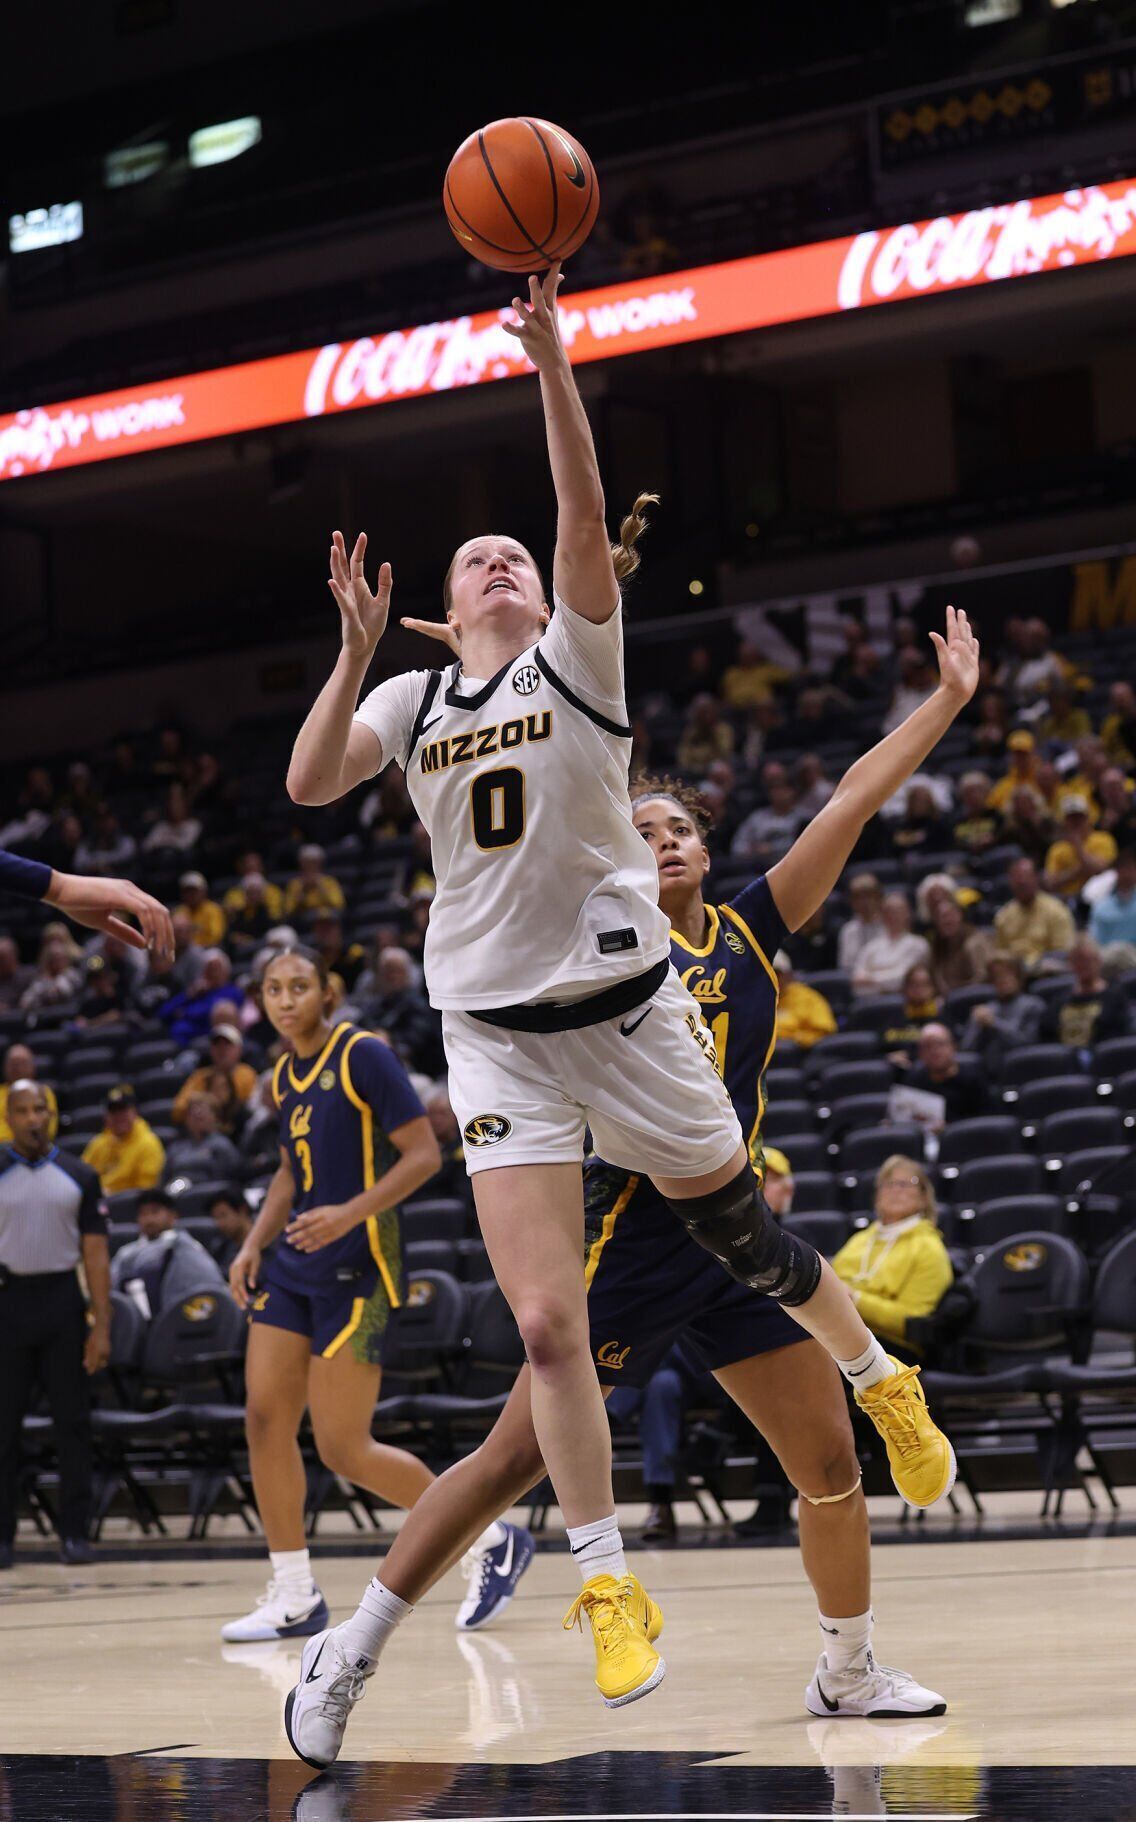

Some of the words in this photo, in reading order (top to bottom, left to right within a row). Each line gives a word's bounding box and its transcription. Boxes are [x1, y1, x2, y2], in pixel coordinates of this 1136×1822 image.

[588, 287, 697, 339] WORK
[91, 393, 185, 441] WORK
[513, 666, 540, 694] SEC
[421, 710, 553, 774] MIZZOU
[470, 765, 526, 852] 0
[680, 965, 727, 1004] Cal
[295, 1139, 314, 1192] 3
[596, 1340, 632, 1370] Cal
